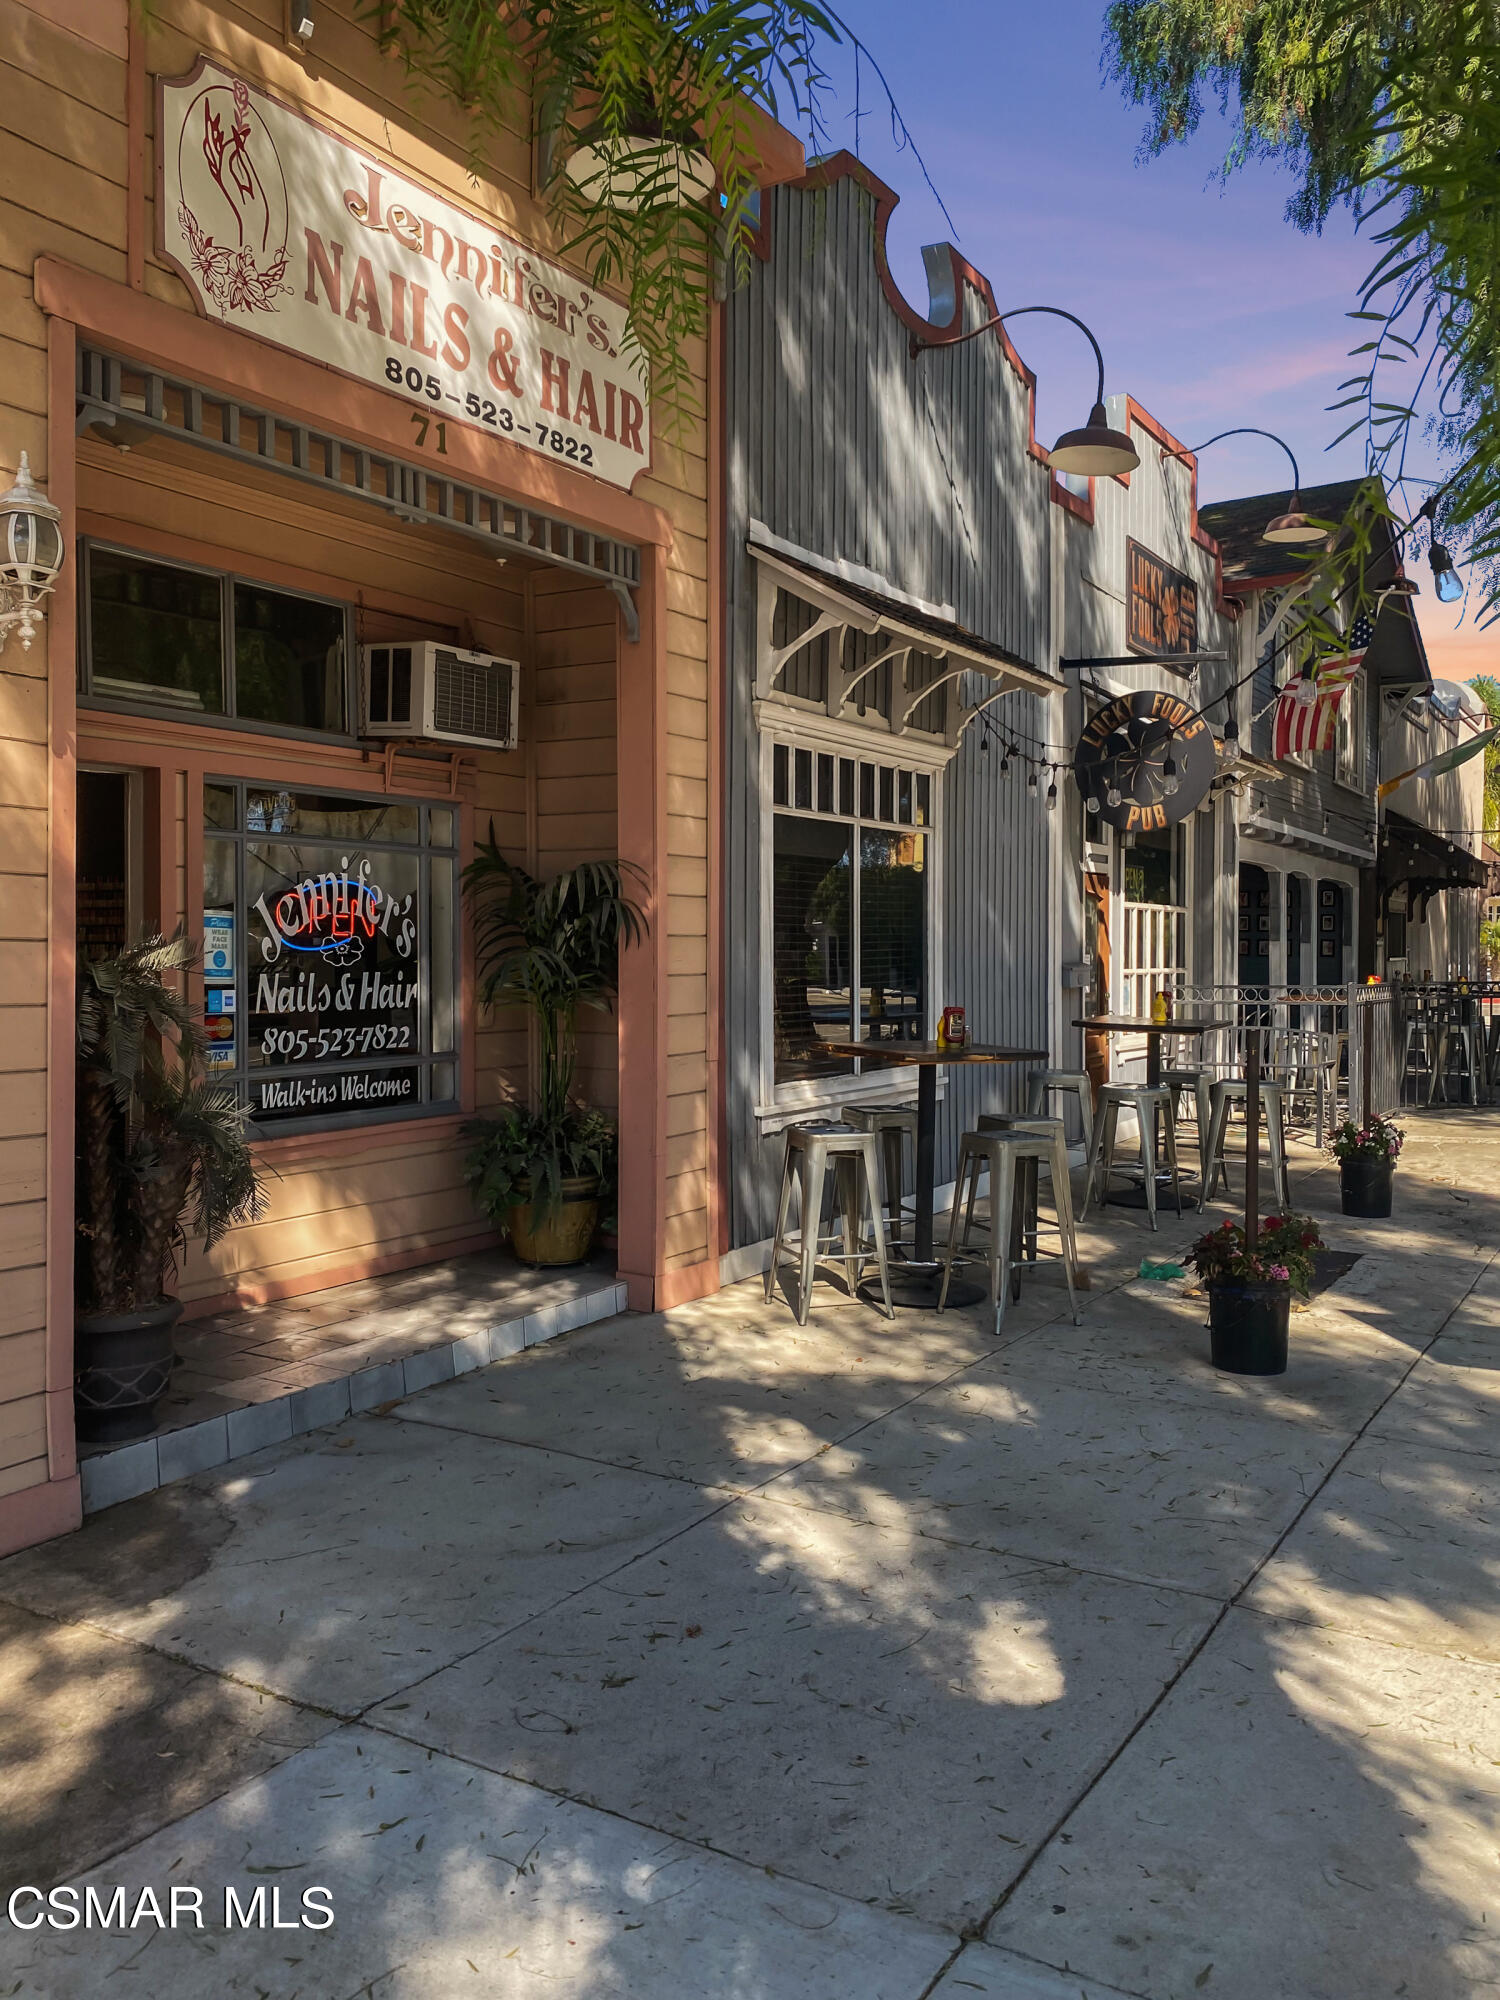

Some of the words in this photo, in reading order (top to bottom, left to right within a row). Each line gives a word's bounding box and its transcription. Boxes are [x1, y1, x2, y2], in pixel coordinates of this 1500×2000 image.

[304, 227, 471, 373] NAILS
[488, 326, 524, 399] &
[539, 346, 644, 455] HAIR
[385, 357, 594, 468] 805-523-7822
[410, 412, 448, 455] 71
[1132, 550, 1163, 606] LUCKY
[1132, 593, 1162, 648] FOOLS
[1081, 695, 1134, 748] LUCKY
[1151, 693, 1206, 739] FOOLS
[1126, 804, 1167, 831] PUB
[252, 856, 416, 963] Jennifer's
[275, 893, 375, 937] OPEN
[255, 972, 331, 1014] Nails
[335, 973, 353, 1011] &
[359, 971, 418, 1010] Hair
[261, 1026, 410, 1060] 805-523-7822
[261, 1078, 337, 1109] Walk-ins
[341, 1075, 411, 1102] Welcome
